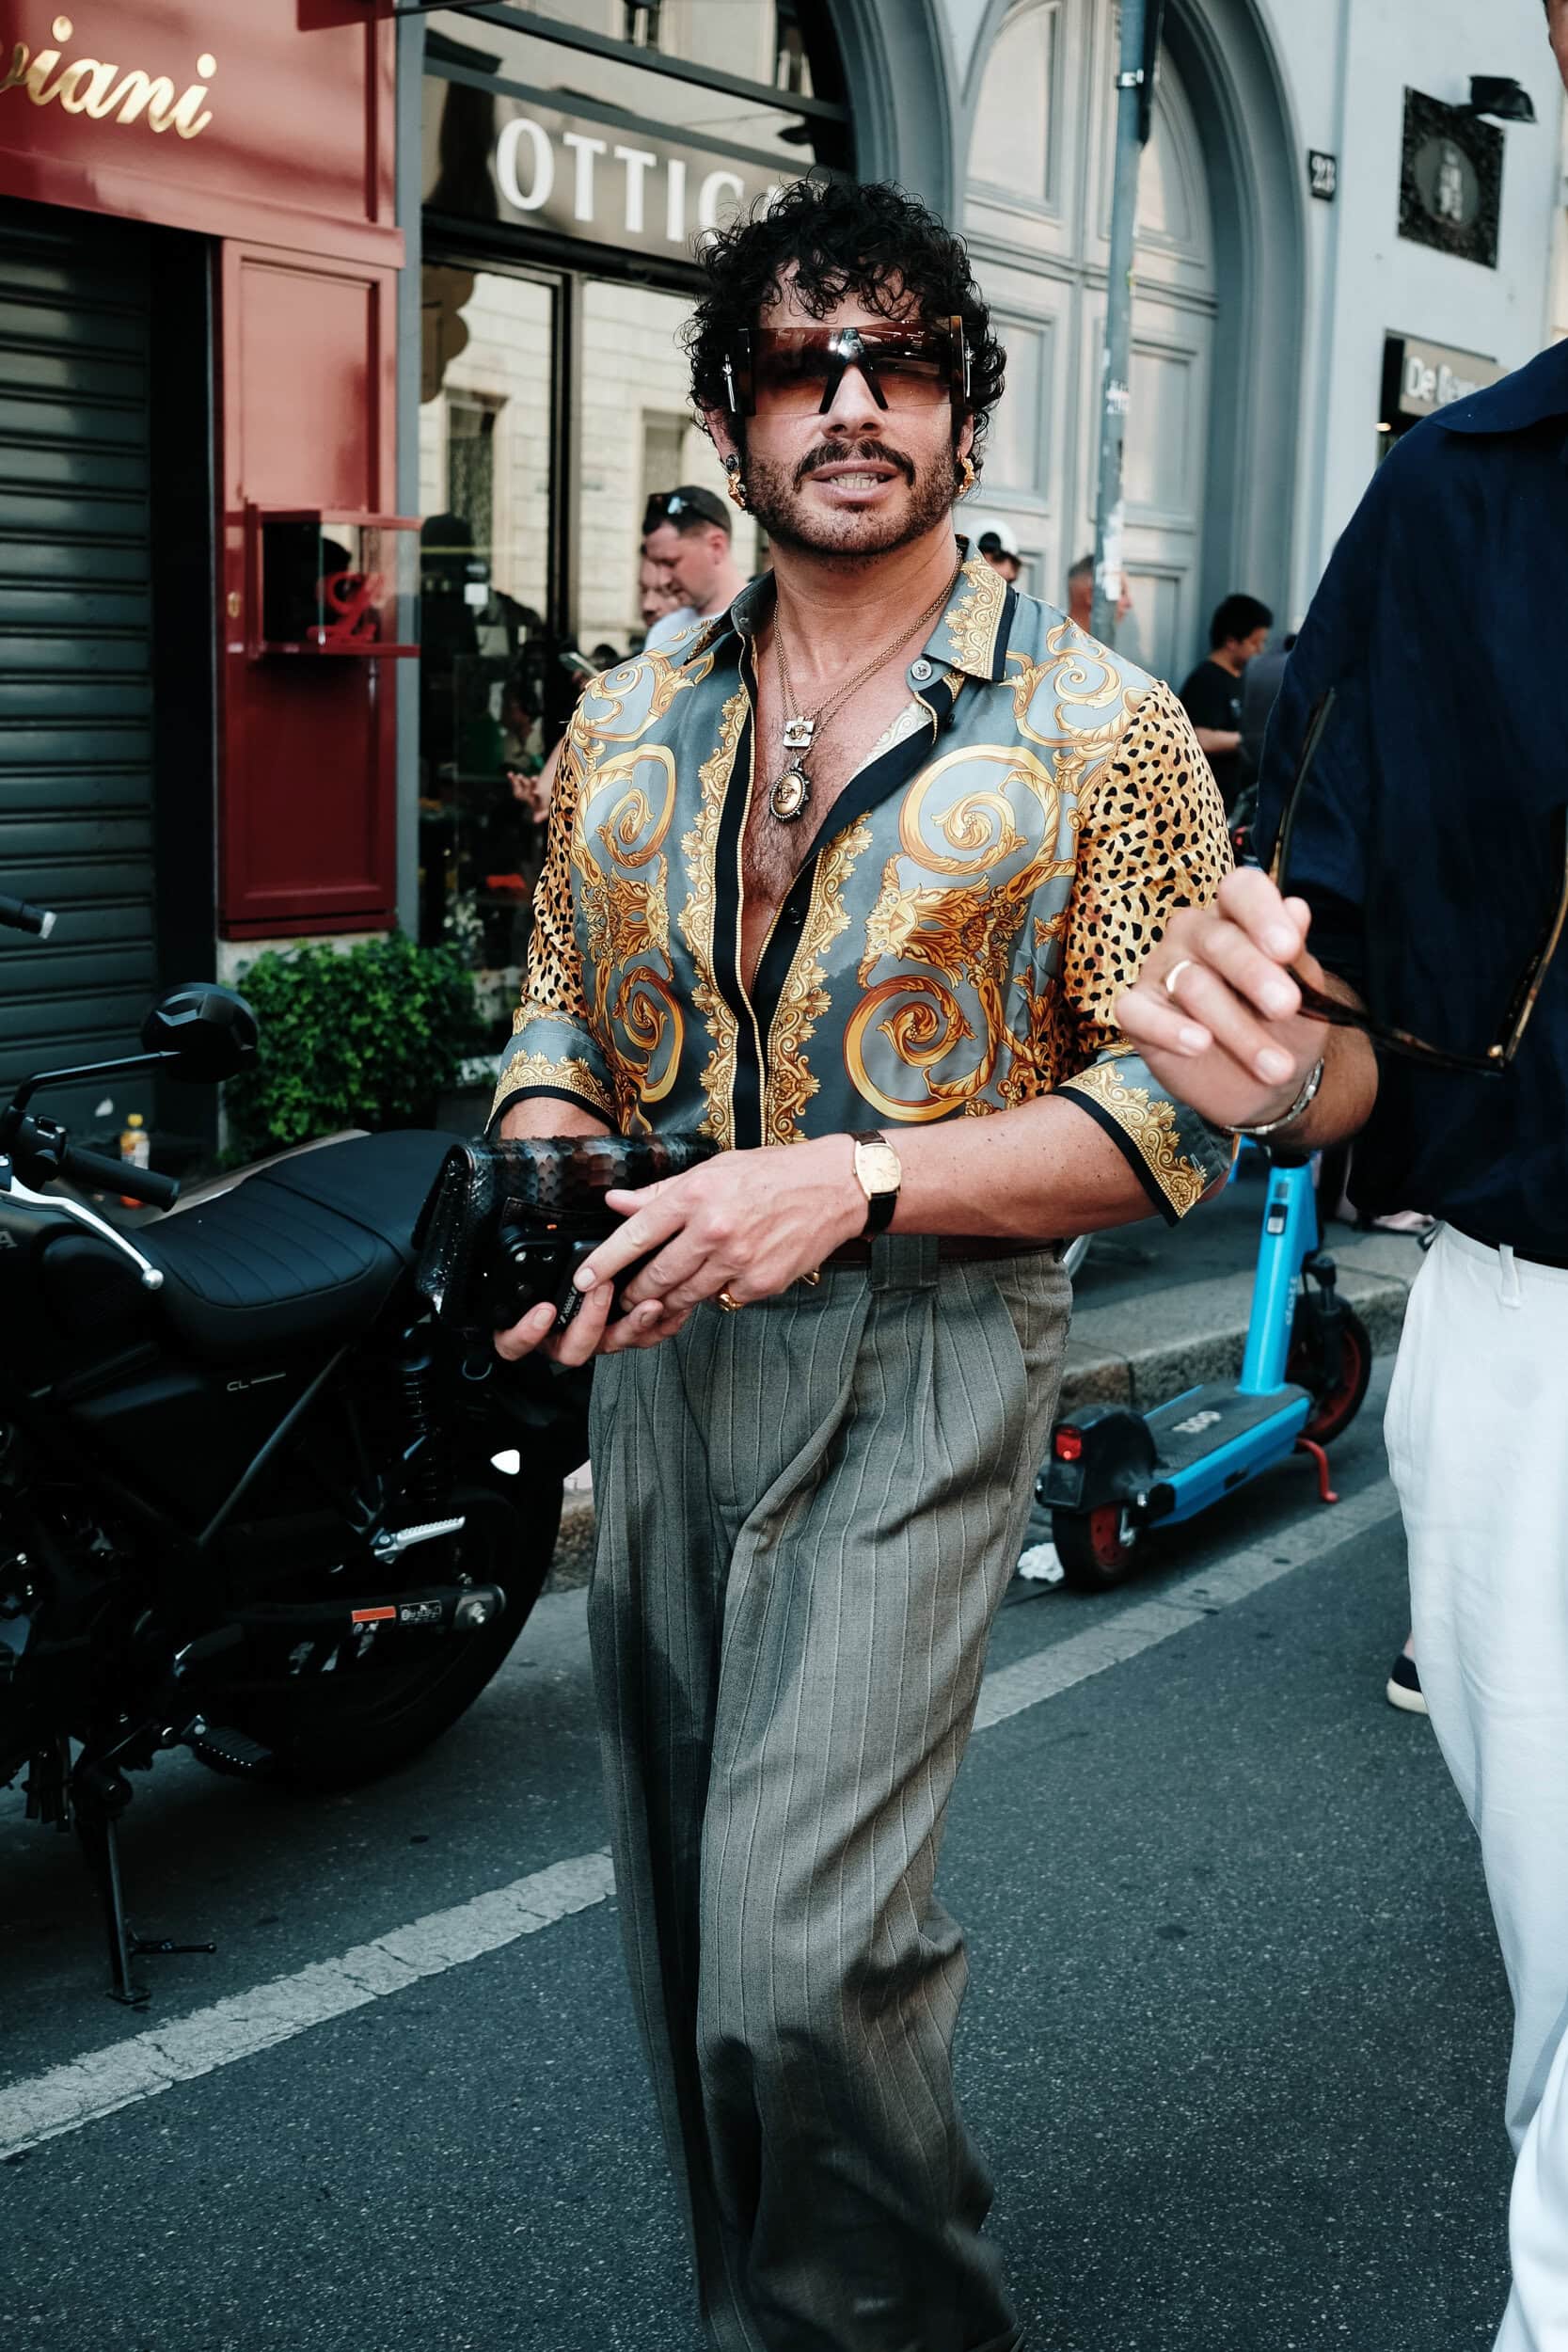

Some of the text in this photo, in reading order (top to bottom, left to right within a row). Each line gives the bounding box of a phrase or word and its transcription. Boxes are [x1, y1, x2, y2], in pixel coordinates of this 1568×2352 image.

[497, 118, 795, 249] OTTIC
[1405, 358, 1436, 402] De
[227, 1380, 249, 1391] CL
